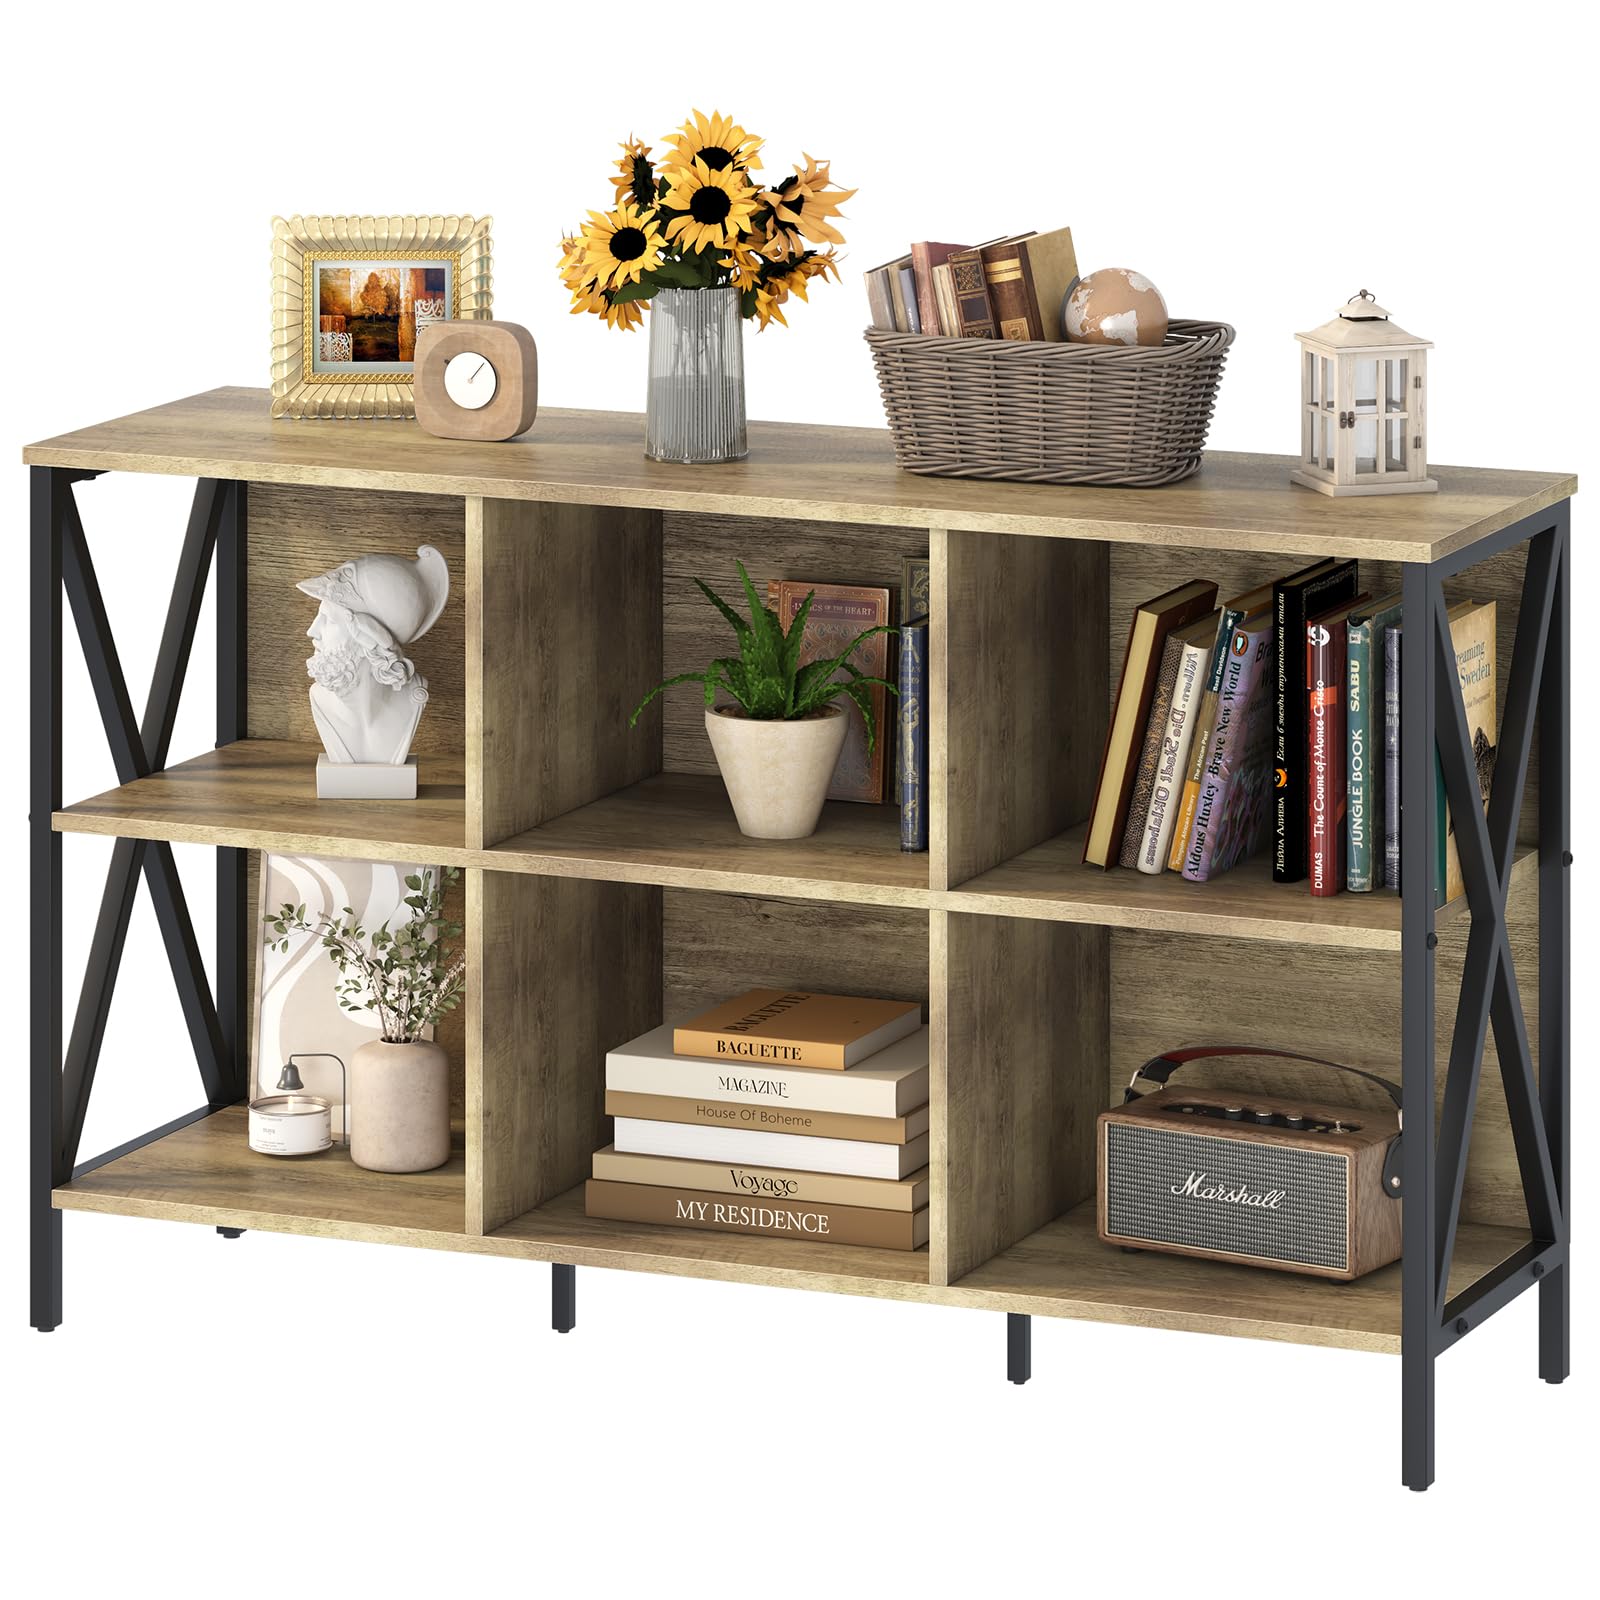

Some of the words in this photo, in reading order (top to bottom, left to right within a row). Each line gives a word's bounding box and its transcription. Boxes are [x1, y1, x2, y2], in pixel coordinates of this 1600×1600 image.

[845, 606, 872, 616] HEART
[1216, 646, 1227, 674] Davidson
[1278, 627, 1287, 691] ступеньками
[1455, 640, 1485, 666] reaming
[1213, 675, 1222, 692] Basil
[1223, 662, 1241, 700] World
[1350, 660, 1360, 712] SABU
[1460, 659, 1491, 689] Sweden
[1277, 694, 1285, 727] звезды
[1313, 680, 1325, 717] Cristo
[1216, 706, 1232, 734] New
[1201, 731, 1209, 745] Past
[1276, 736, 1285, 761] Если
[1314, 719, 1325, 758] Monte
[1352, 729, 1363, 781] BOOK
[1208, 737, 1226, 778] Brave
[1316, 759, 1327, 772] of
[1314, 774, 1325, 811] Count
[1175, 839, 1184, 865] Penguin
[1180, 816, 1190, 838] African
[1186, 794, 1196, 815] Library
[1188, 831, 1206, 877] Aldous
[1197, 783, 1219, 828] Huxley
[1314, 814, 1325, 837] The
[1352, 786, 1363, 848] JUNGLE
[1314, 851, 1323, 889] DUMAS
[722, 994, 812, 1032] BAGUETTE
[716, 1040, 802, 1061] BAGUETTE
[718, 1075, 790, 1099] MAGAZINE
[696, 1104, 736, 1120] House
[740, 1108, 757, 1121] Of
[760, 1111, 813, 1128] Boheme
[730, 1169, 799, 1198] Voyage
[1171, 1171, 1286, 1210] Marshall
[676, 1199, 709, 1220] MY
[713, 1203, 830, 1234] RESIDENCE
